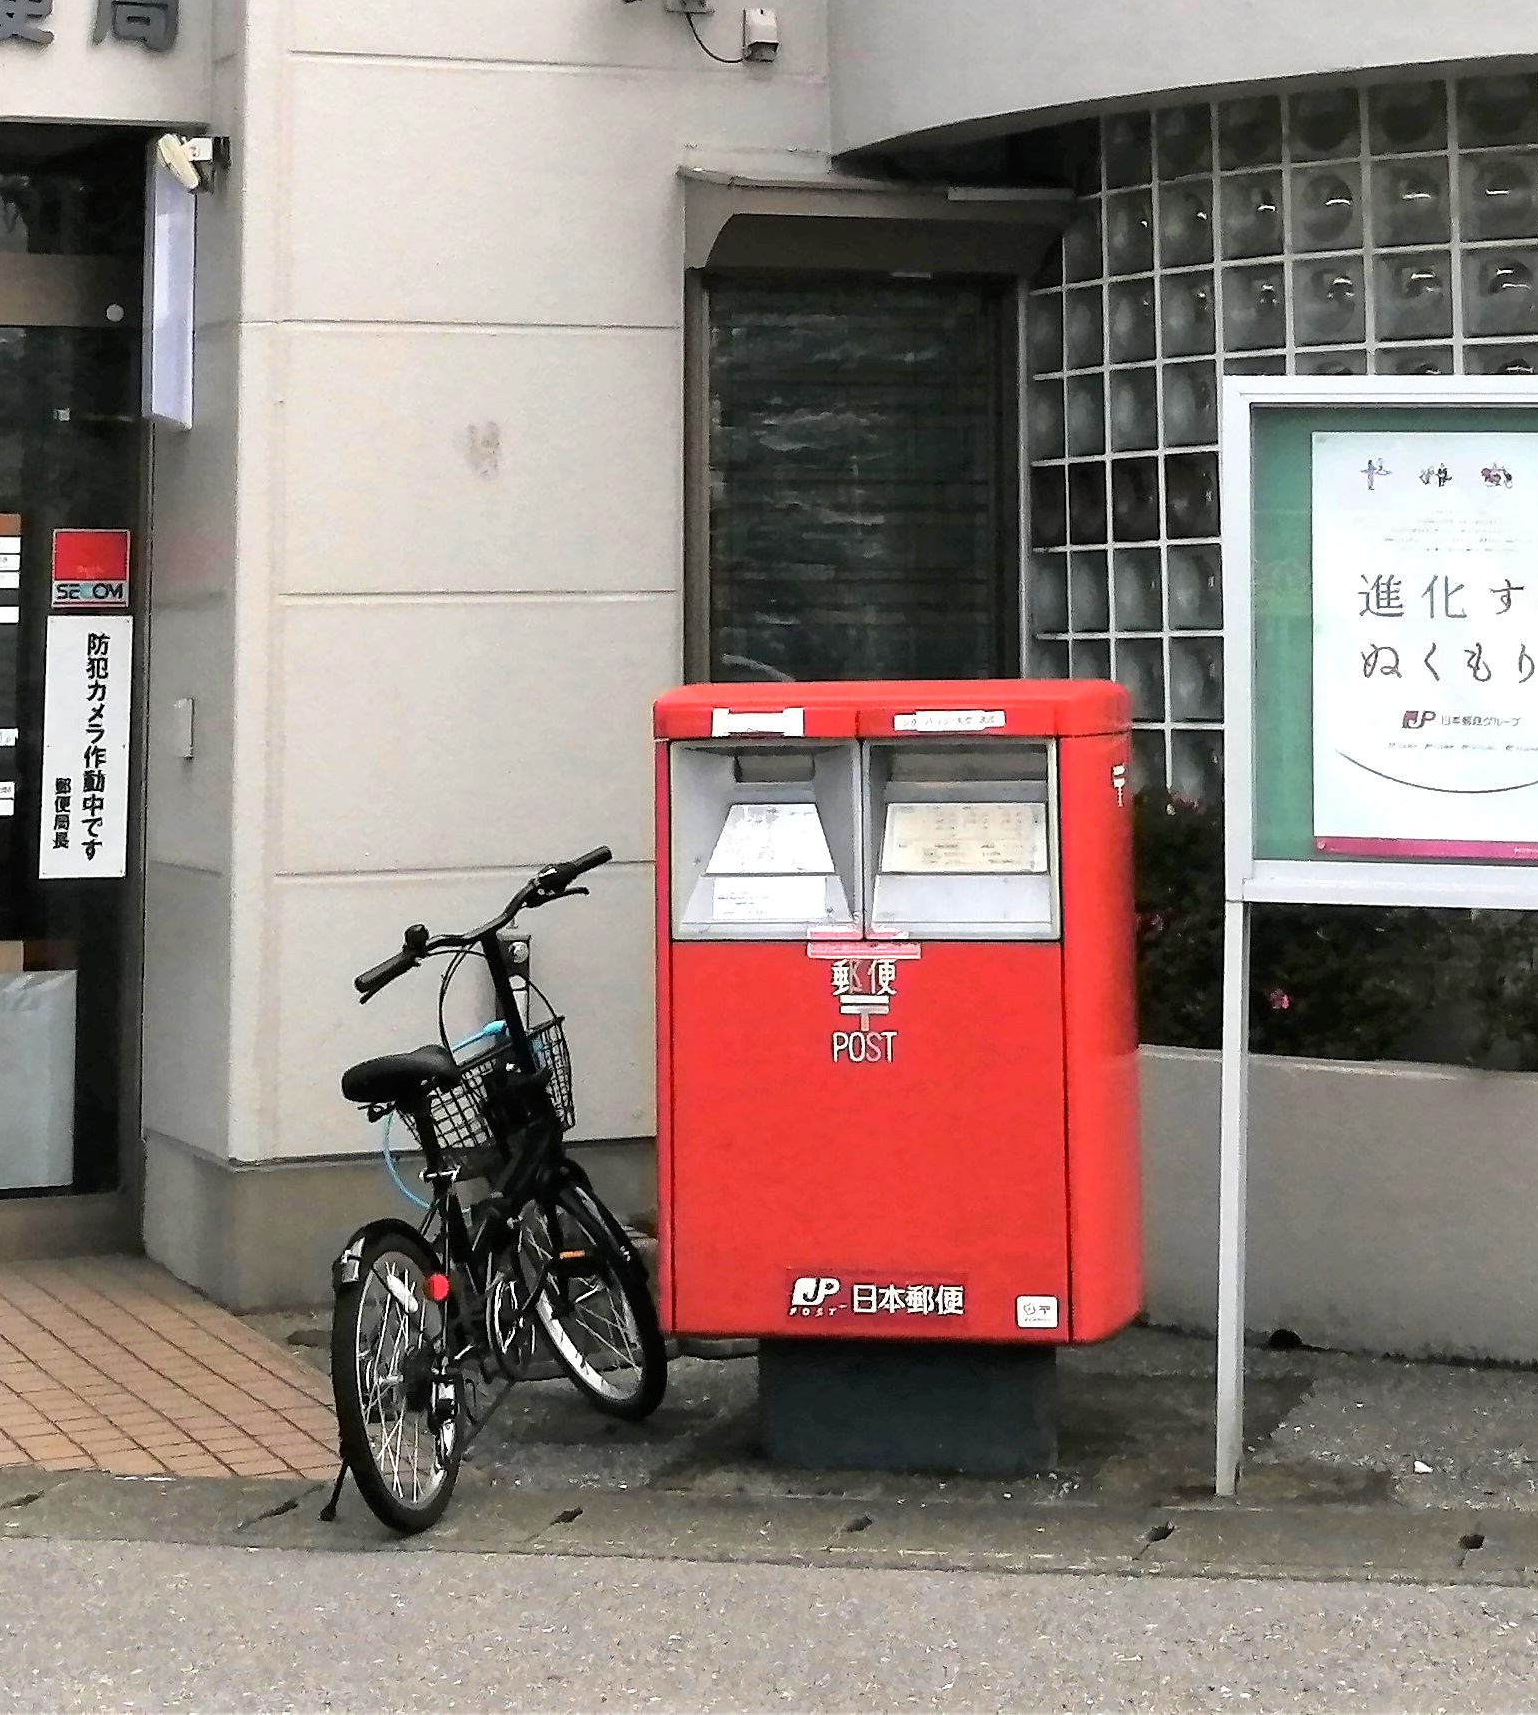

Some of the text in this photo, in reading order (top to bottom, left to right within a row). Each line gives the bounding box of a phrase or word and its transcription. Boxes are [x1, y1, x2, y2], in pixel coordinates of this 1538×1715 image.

[81, 632, 111, 861] 防犯カメラ作動中です
[52, 776, 72, 849] 郵便局長
[830, 959, 898, 996] 郵便
[832, 1031, 898, 1064] POST
[852, 1283, 965, 1316] 日本郵便
